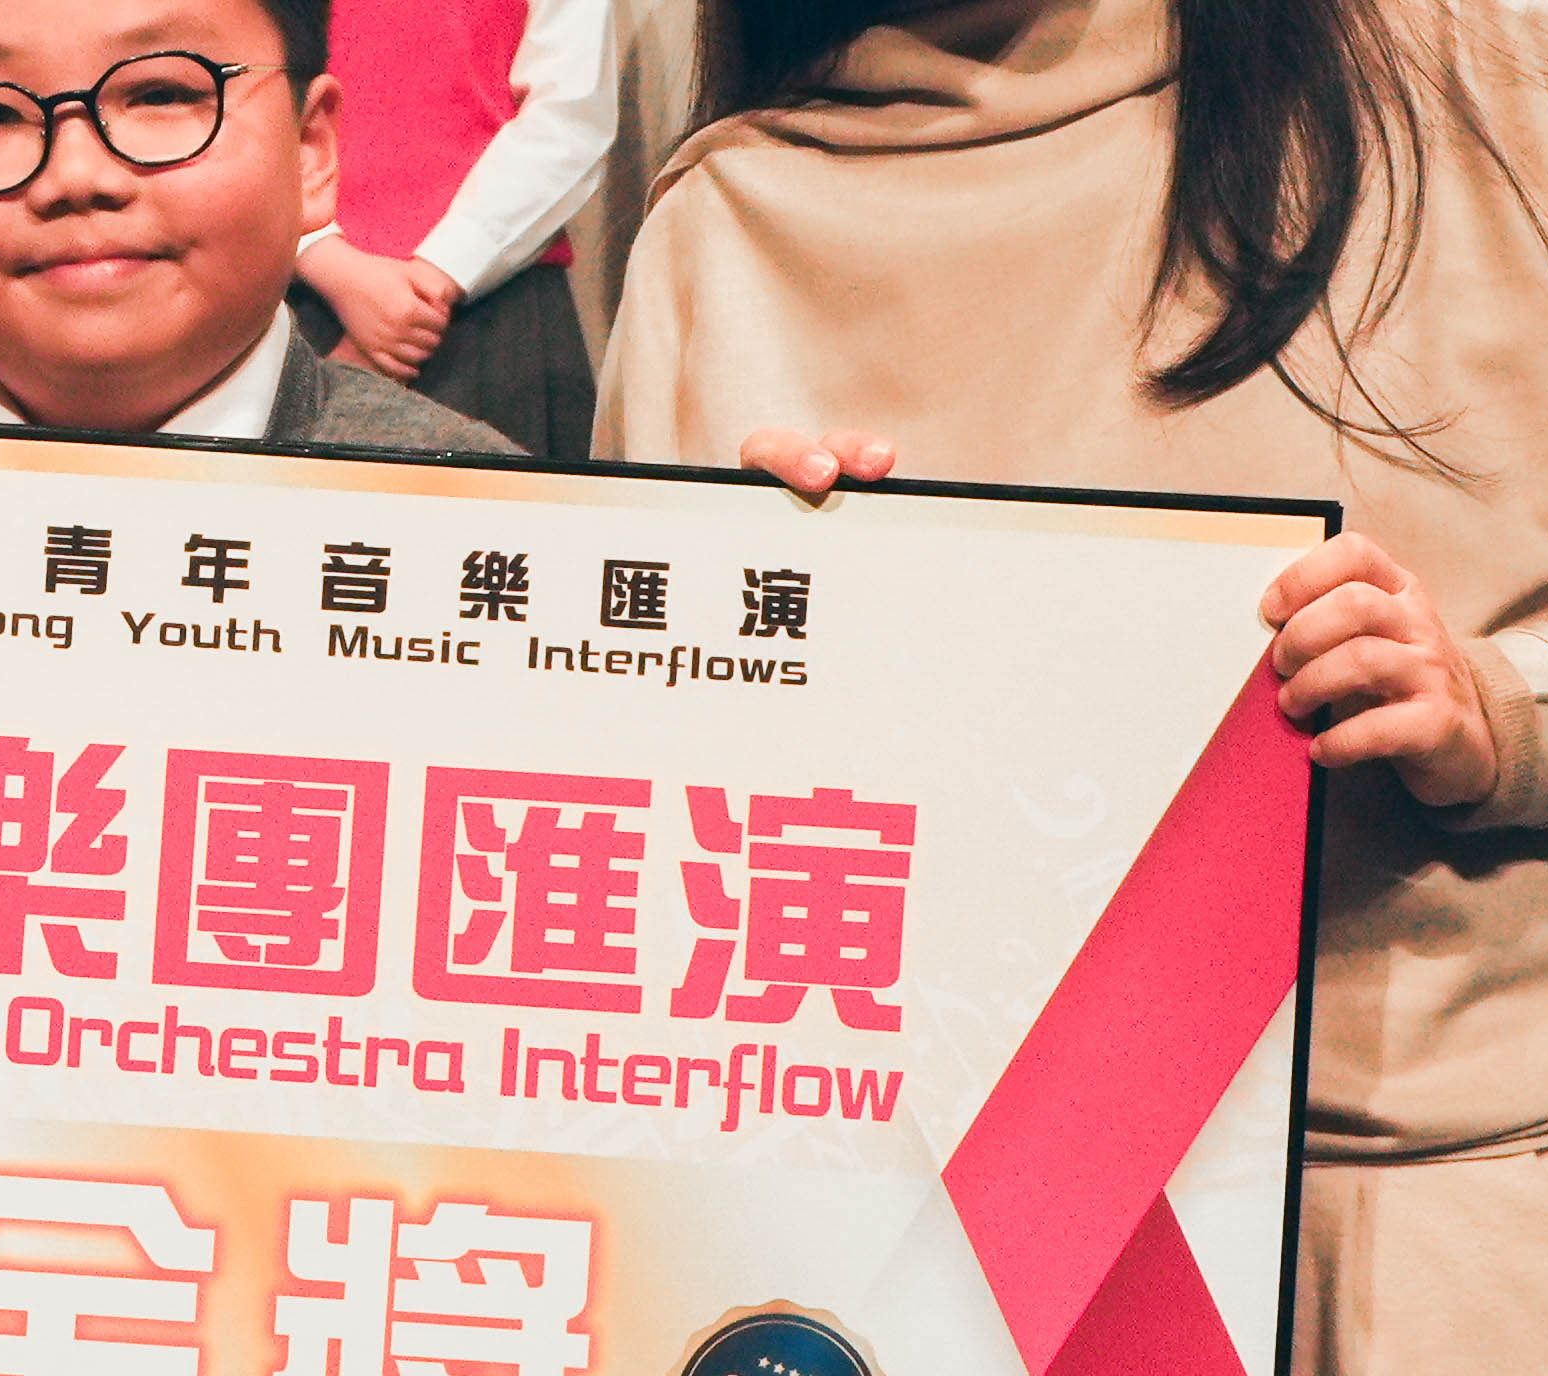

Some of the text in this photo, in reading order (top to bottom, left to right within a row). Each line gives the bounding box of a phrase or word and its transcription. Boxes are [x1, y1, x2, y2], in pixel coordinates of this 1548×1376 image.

[122, 612, 281, 652] Youth
[329, 625, 480, 665] Music
[529, 637, 807, 686] Interflows
[6, 996, 464, 1093] Orchestra
[501, 1028, 903, 1129] Interflow
